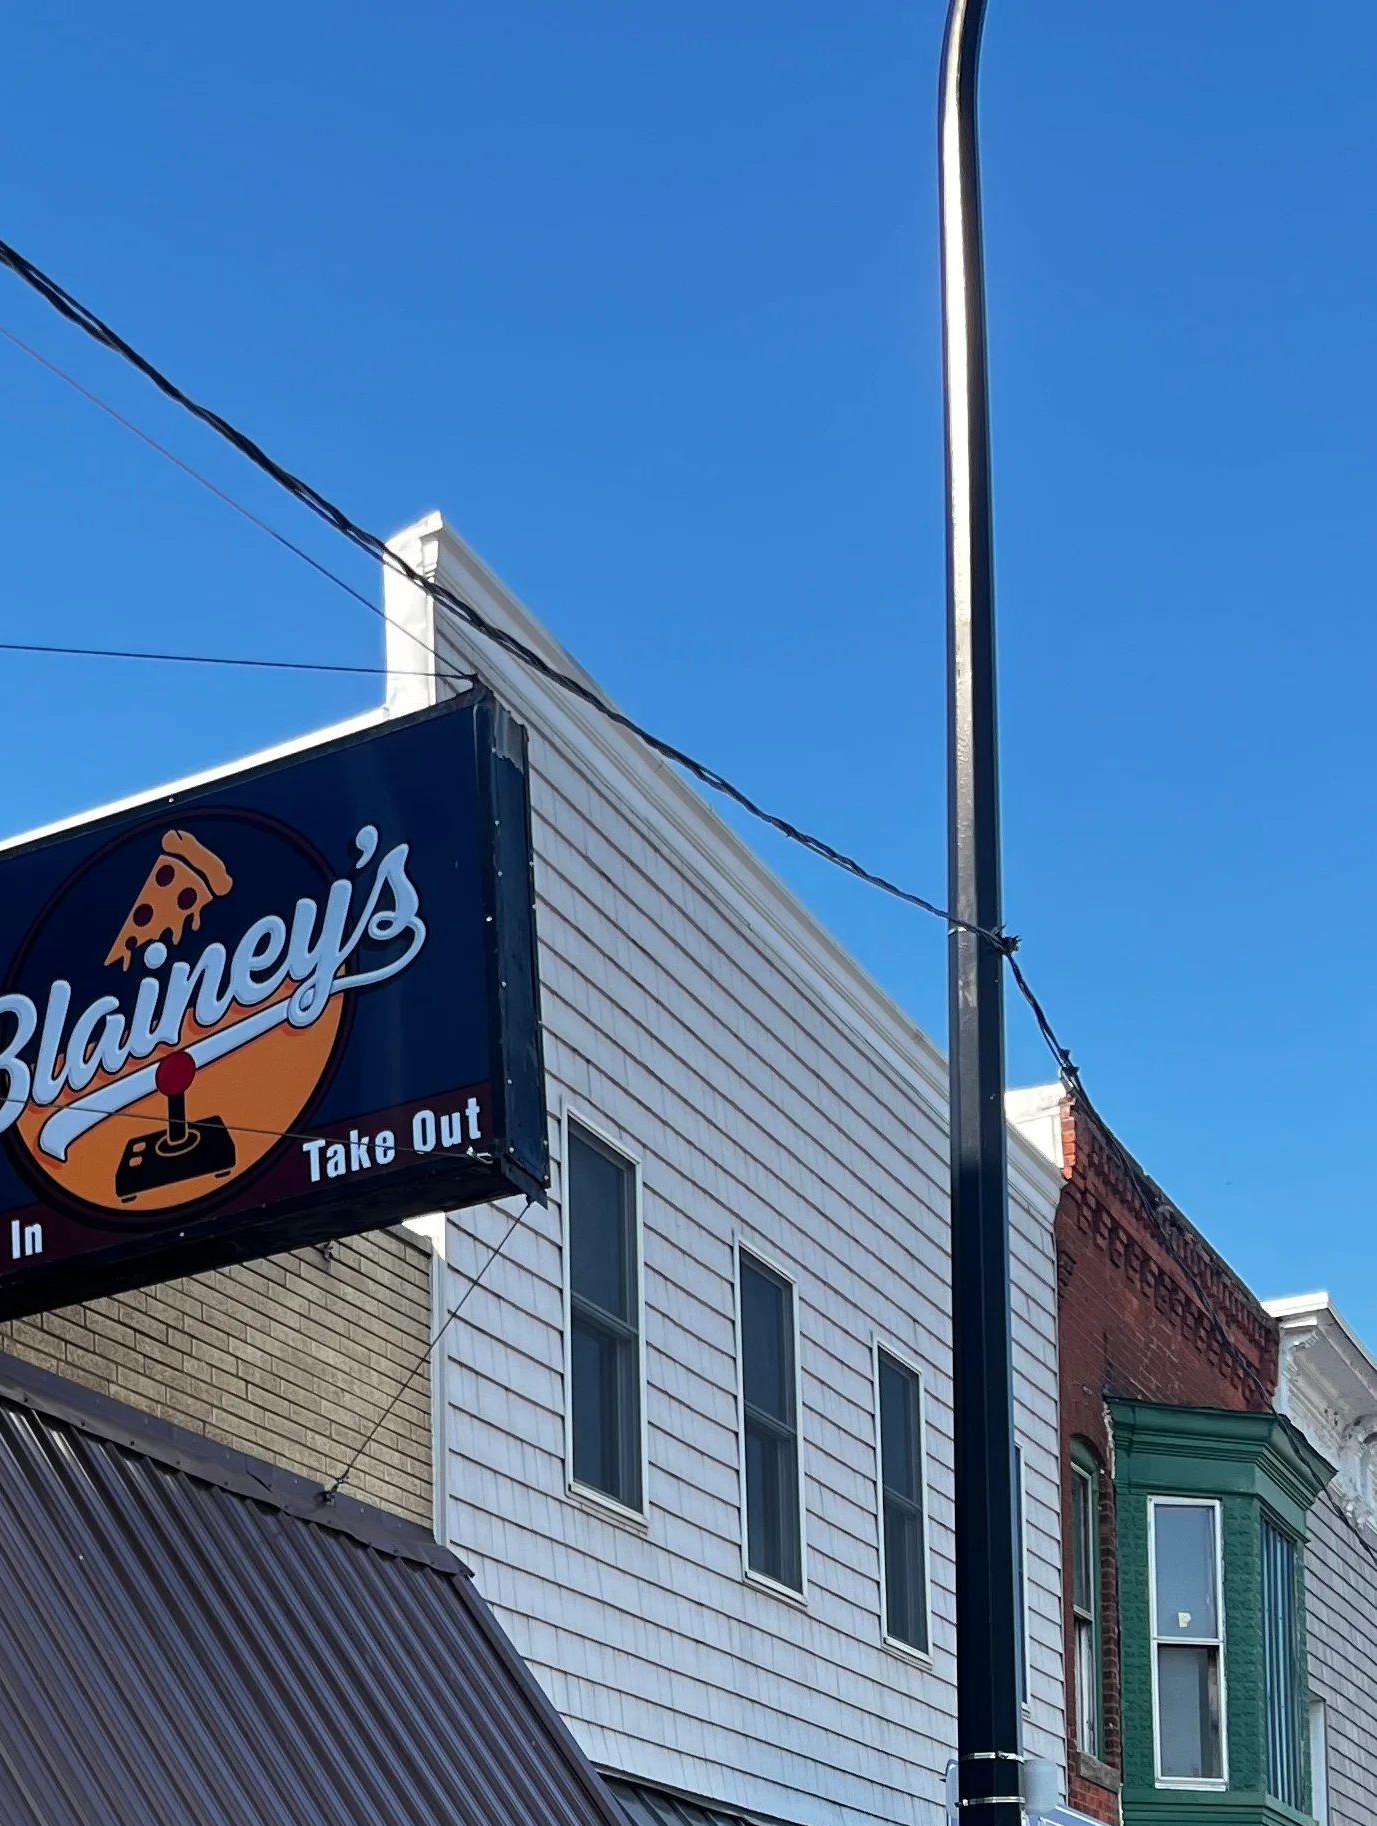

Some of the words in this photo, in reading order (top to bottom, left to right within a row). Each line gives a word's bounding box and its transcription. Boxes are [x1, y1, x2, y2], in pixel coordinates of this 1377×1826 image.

[303, 1129, 397, 1183] Take
[412, 1096, 483, 1156] Out
[10, 1218, 43, 1260] In
